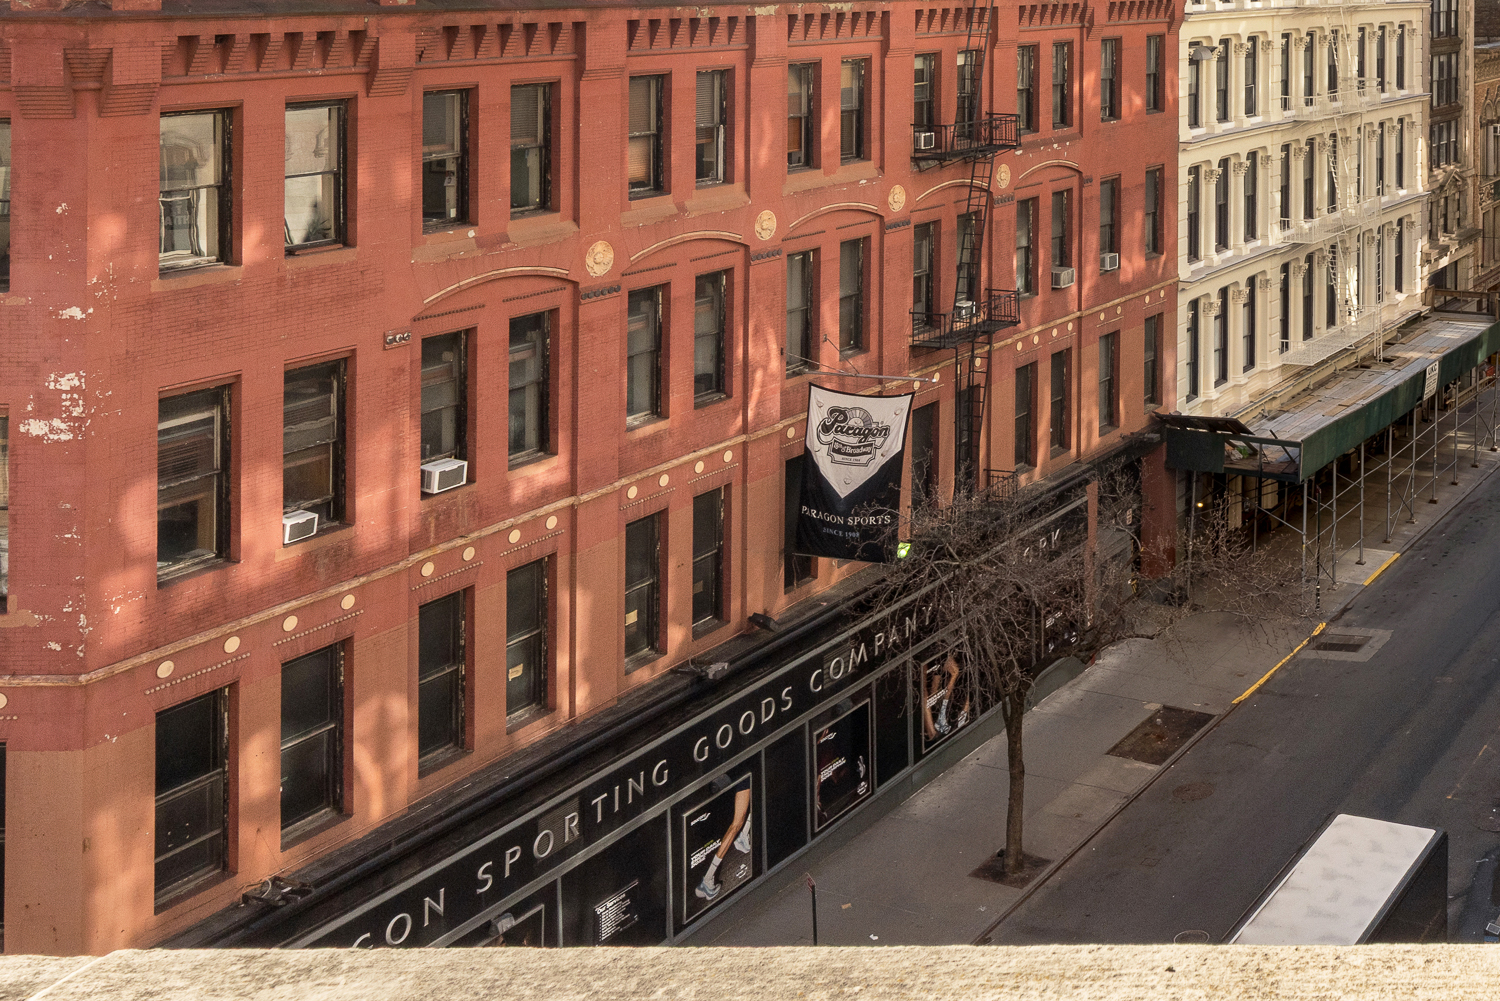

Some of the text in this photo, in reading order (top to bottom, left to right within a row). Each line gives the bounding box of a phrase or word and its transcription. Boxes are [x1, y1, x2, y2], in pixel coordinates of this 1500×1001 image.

[819, 407, 890, 444] Paragon
[846, 446, 872, 454] Broadway
[801, 505, 891, 526] PARAGON SPORTS
[822, 526, 844, 537] SINCE
[476, 757, 670, 894] SPORTING
[693, 686, 794, 763] GOODS
[809, 603, 934, 693] COMPANY
